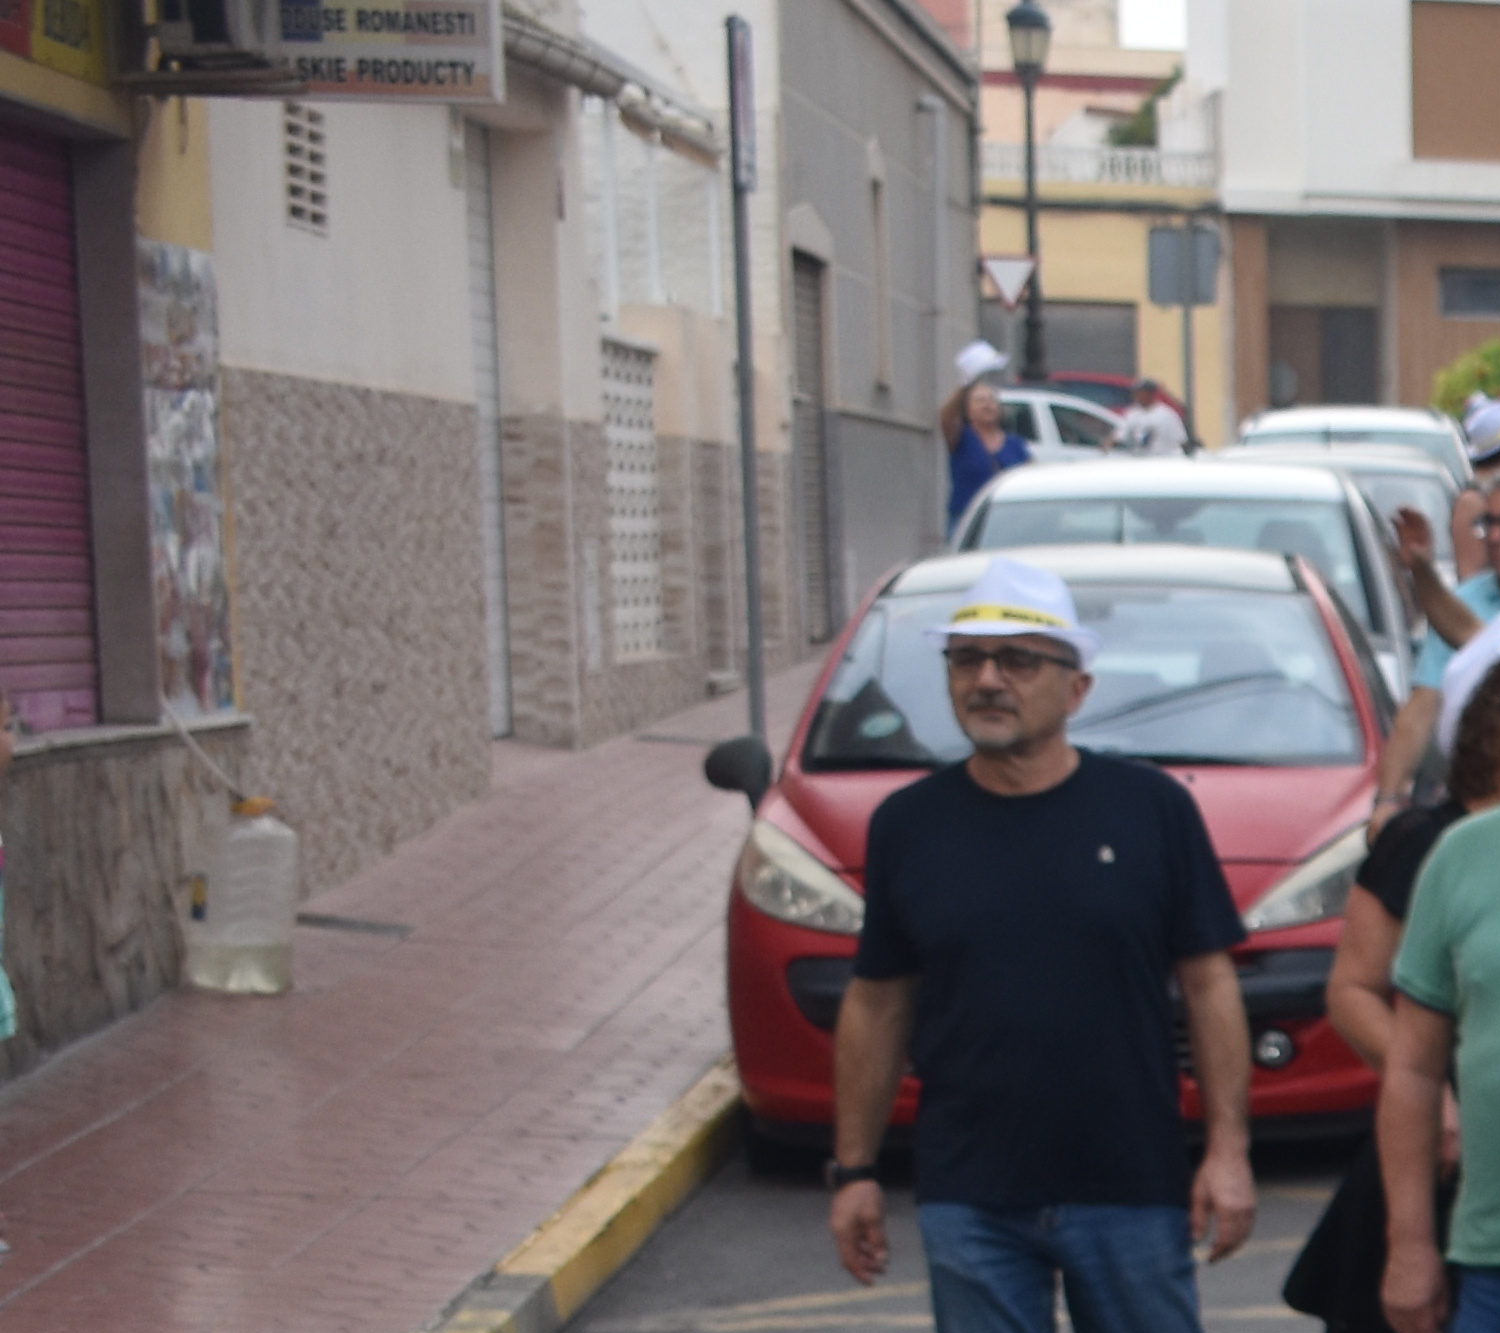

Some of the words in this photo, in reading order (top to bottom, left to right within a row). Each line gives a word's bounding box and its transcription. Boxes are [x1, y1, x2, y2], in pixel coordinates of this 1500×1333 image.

[356, 8, 476, 36] ROMANESTI
[291, 56, 347, 84] SKIE
[356, 57, 476, 86] PRODUCTY
